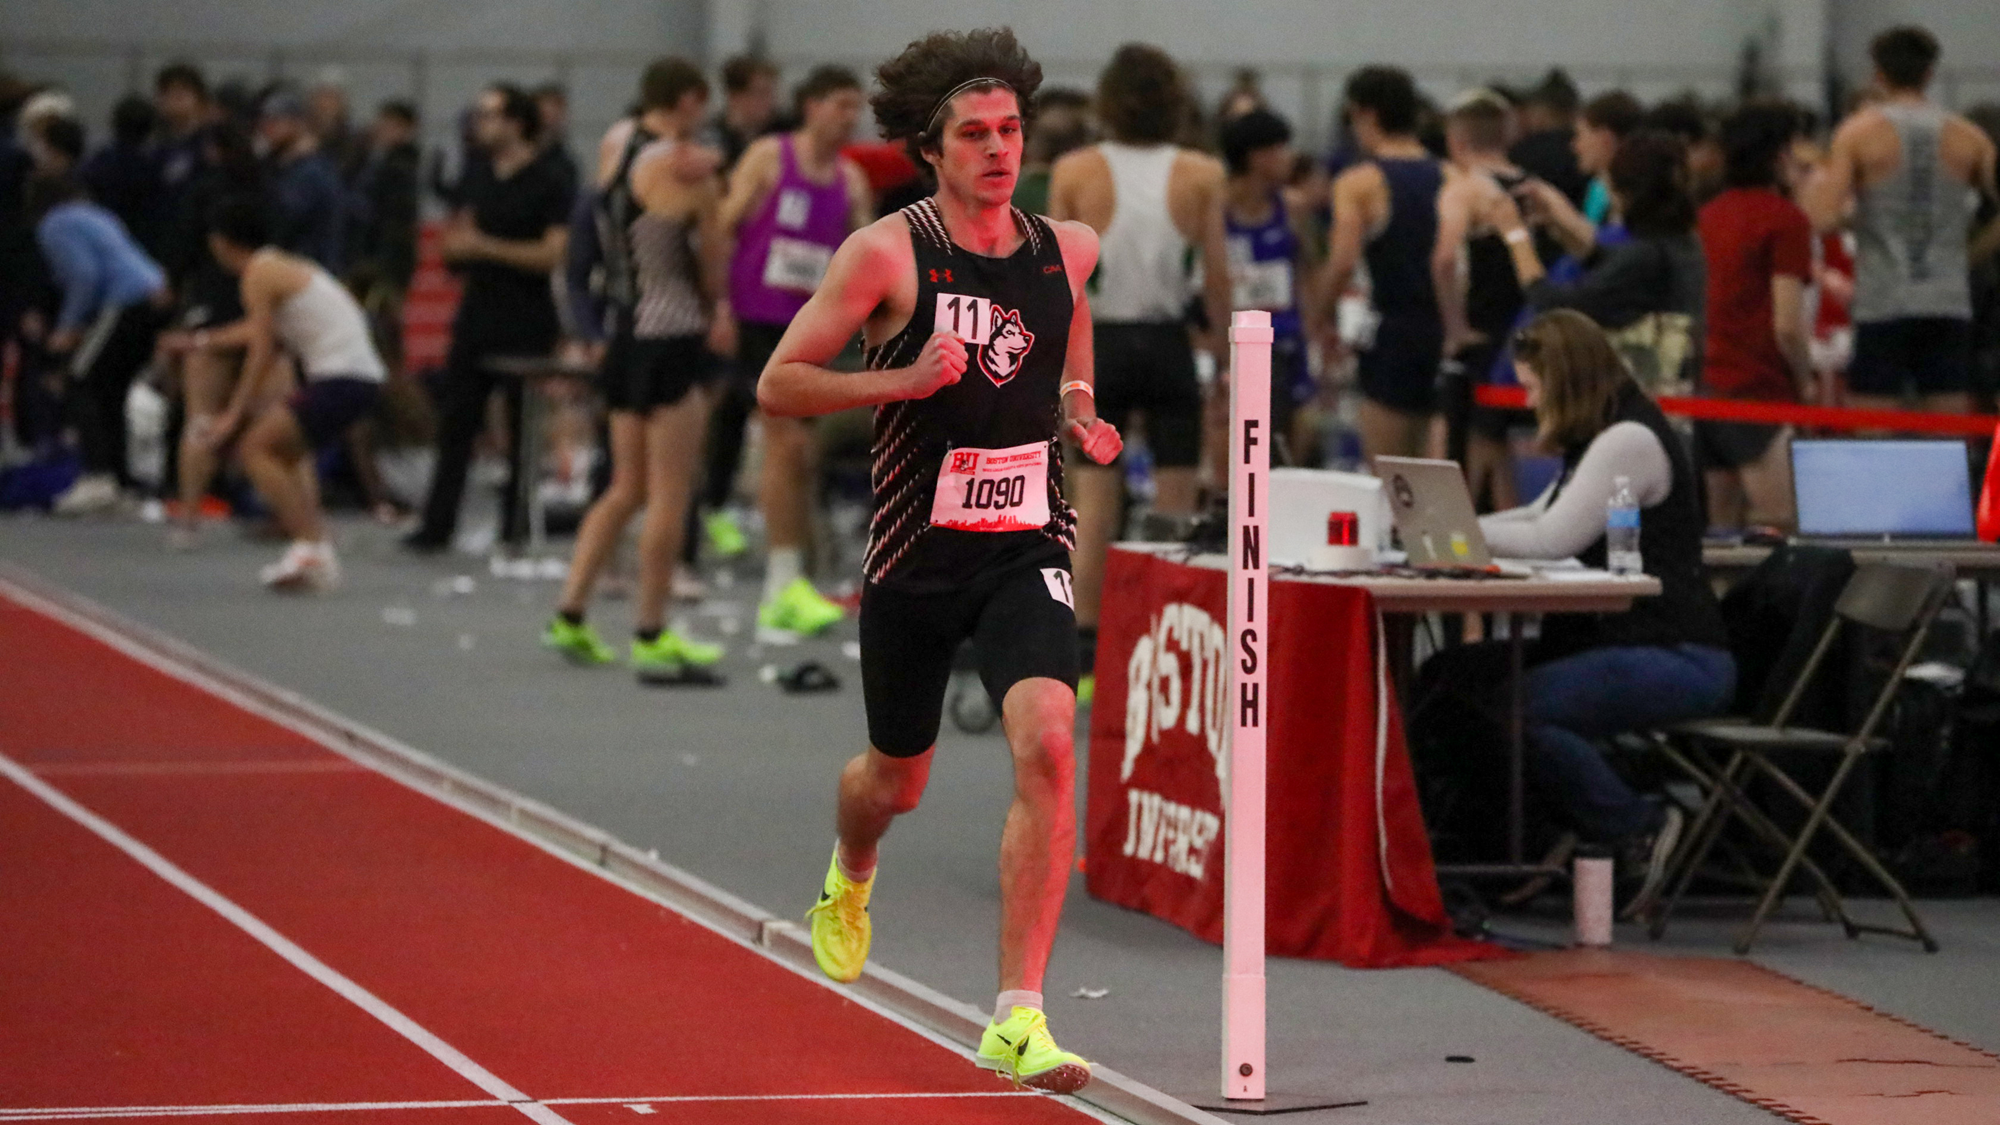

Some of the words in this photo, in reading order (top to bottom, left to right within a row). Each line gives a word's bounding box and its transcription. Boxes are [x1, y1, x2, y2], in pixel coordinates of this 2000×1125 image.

[947, 297, 978, 339] 11
[951, 452, 980, 471] BU
[986, 456, 1009, 465] BOSTON
[1009, 450, 1042, 463] UNIVERSITY
[962, 475, 1025, 510] 1090
[1239, 419, 1260, 728] FINISH
